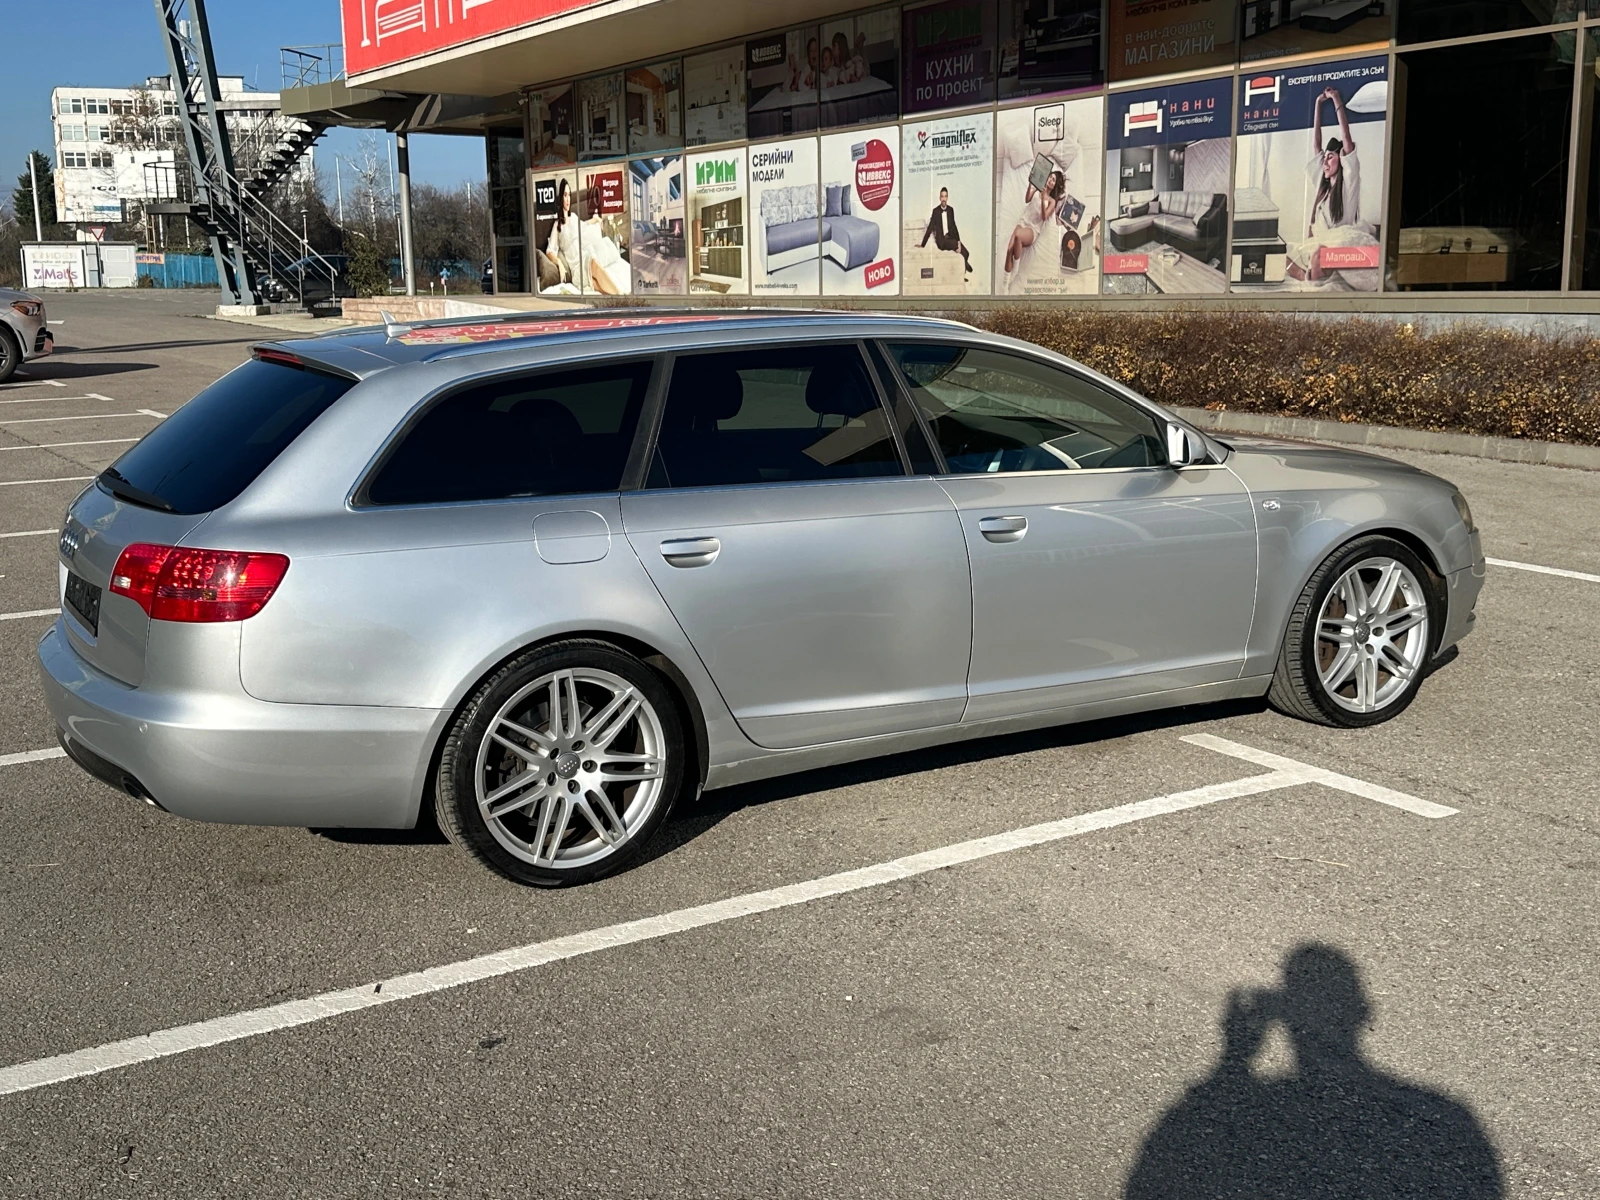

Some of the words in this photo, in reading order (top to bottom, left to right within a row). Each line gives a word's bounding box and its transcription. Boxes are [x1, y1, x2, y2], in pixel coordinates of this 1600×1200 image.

[1125, 34, 1215, 66] МАГАЗИНИ
[925, 53, 974, 81] КУХНИ
[1288, 76, 1318, 86] ЕКСПЕРТИ
[1322, 68, 1361, 81] ПРОДУКТИТЕ
[916, 85, 933, 101] по
[936, 76, 984, 101] проект
[1038, 117, 1062, 128] iSleep
[932, 128, 977, 148] magniflex
[752, 147, 793, 167] СЕРИЙНИ
[857, 161, 885, 170] ПРОИЗВЕДЕНО
[752, 168, 785, 183] МОДЕЛИ
[1119, 257, 1144, 268] Дивани
[1326, 250, 1367, 263] Матраци
[868, 269, 891, 283] НОВО
